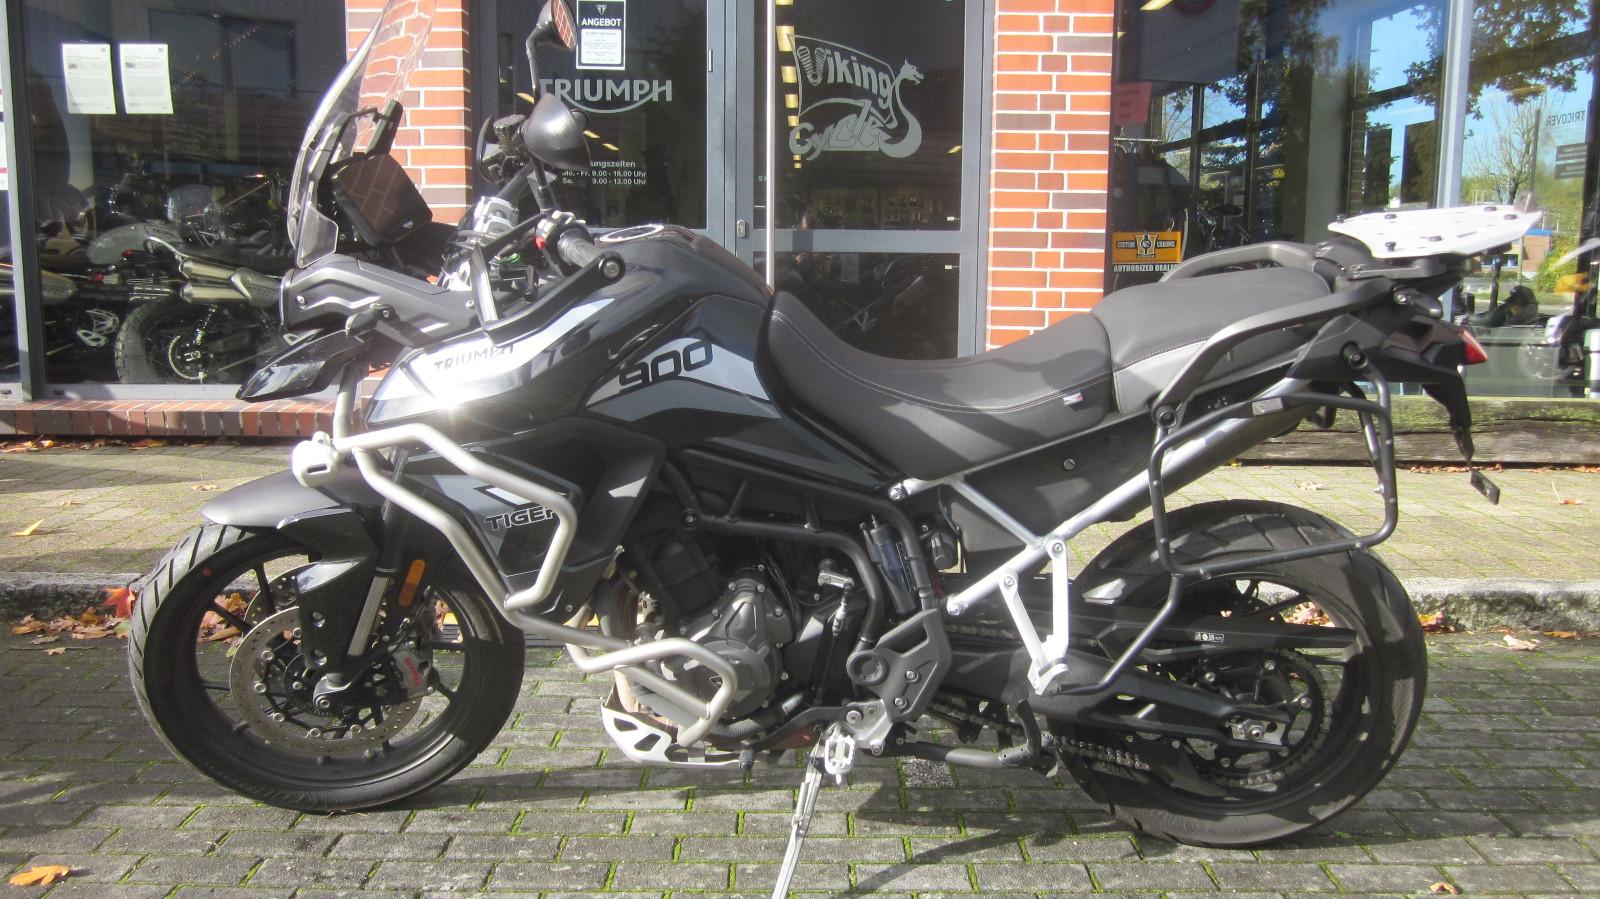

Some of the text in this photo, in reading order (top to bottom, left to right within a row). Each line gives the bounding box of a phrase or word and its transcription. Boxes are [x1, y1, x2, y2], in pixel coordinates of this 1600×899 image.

[581, 18, 621, 26] ANGEBOT
[796, 45, 892, 109] Viking
[540, 79, 672, 113] TRIUMPH
[591, 160, 636, 168] ungszeiten
[619, 341, 713, 387] 900
